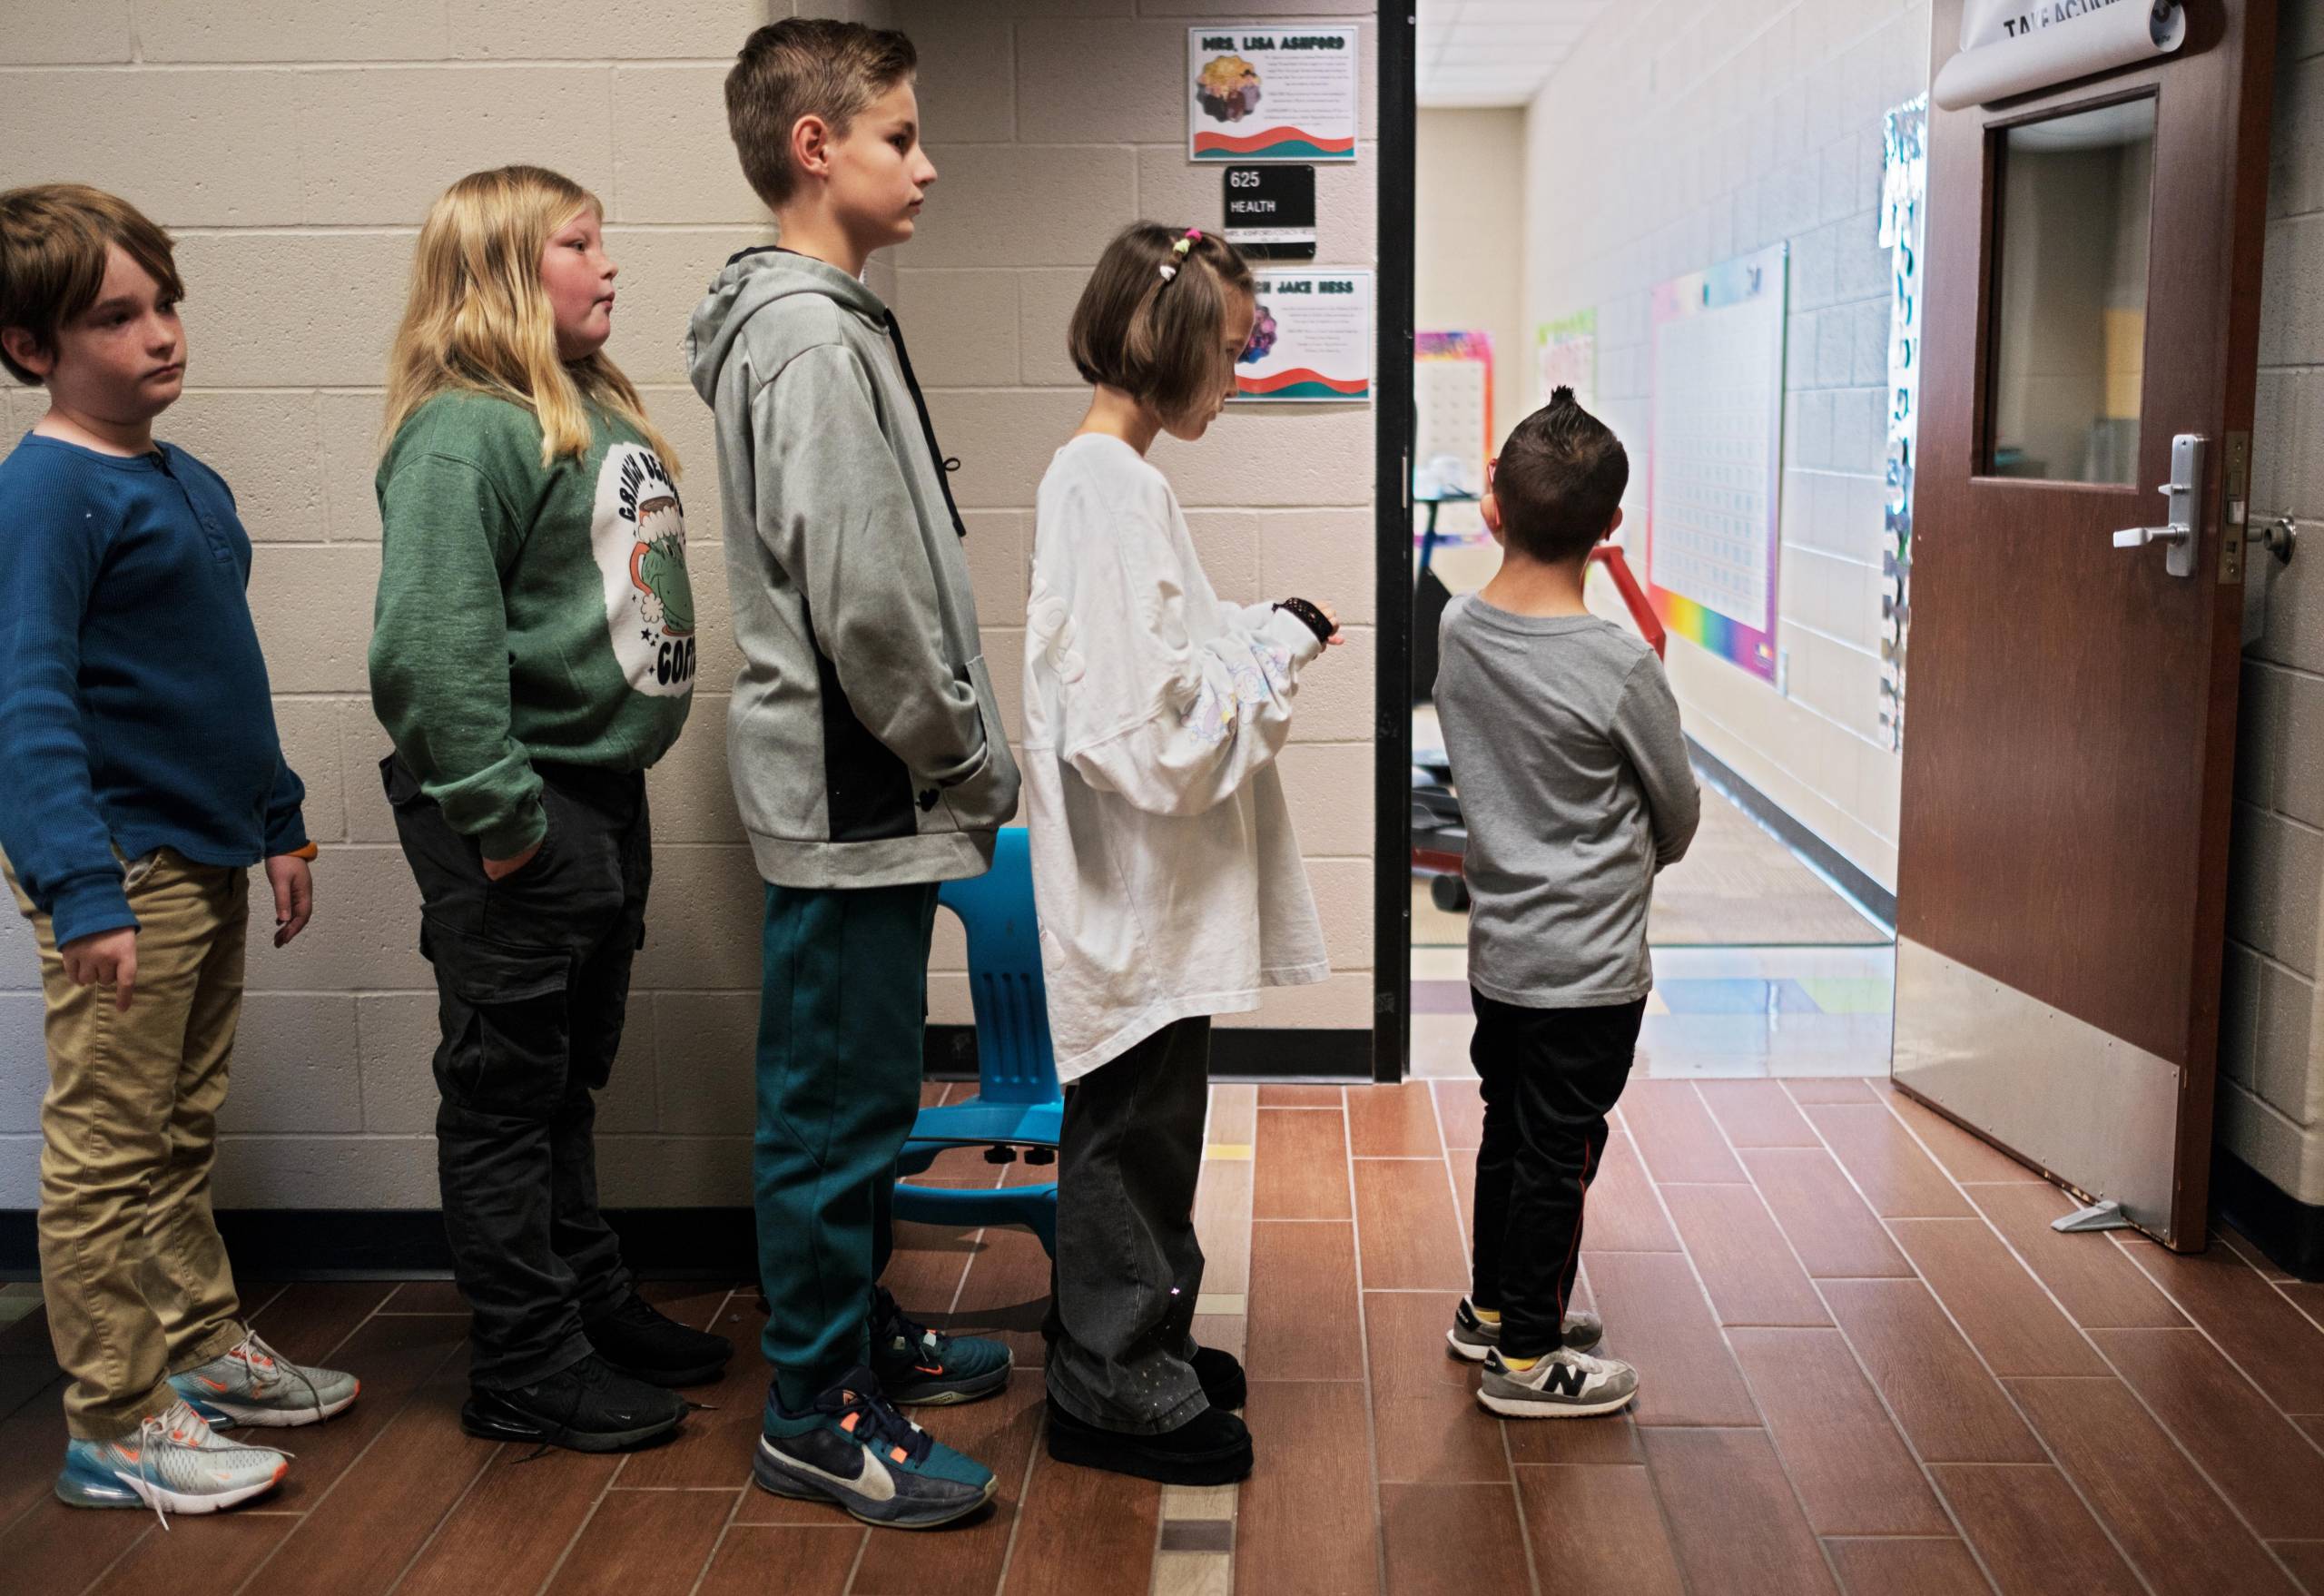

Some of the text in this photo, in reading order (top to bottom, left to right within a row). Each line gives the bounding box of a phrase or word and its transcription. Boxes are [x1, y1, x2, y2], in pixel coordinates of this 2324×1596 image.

[1243, 36, 1275, 51] LISA
[1280, 35, 1344, 50] ASHFORD
[1230, 172, 1260, 187] 625
[1230, 201, 1275, 212] HEALTH
[1277, 281, 1312, 293] JAKE
[619, 453, 645, 523] GRINCH
